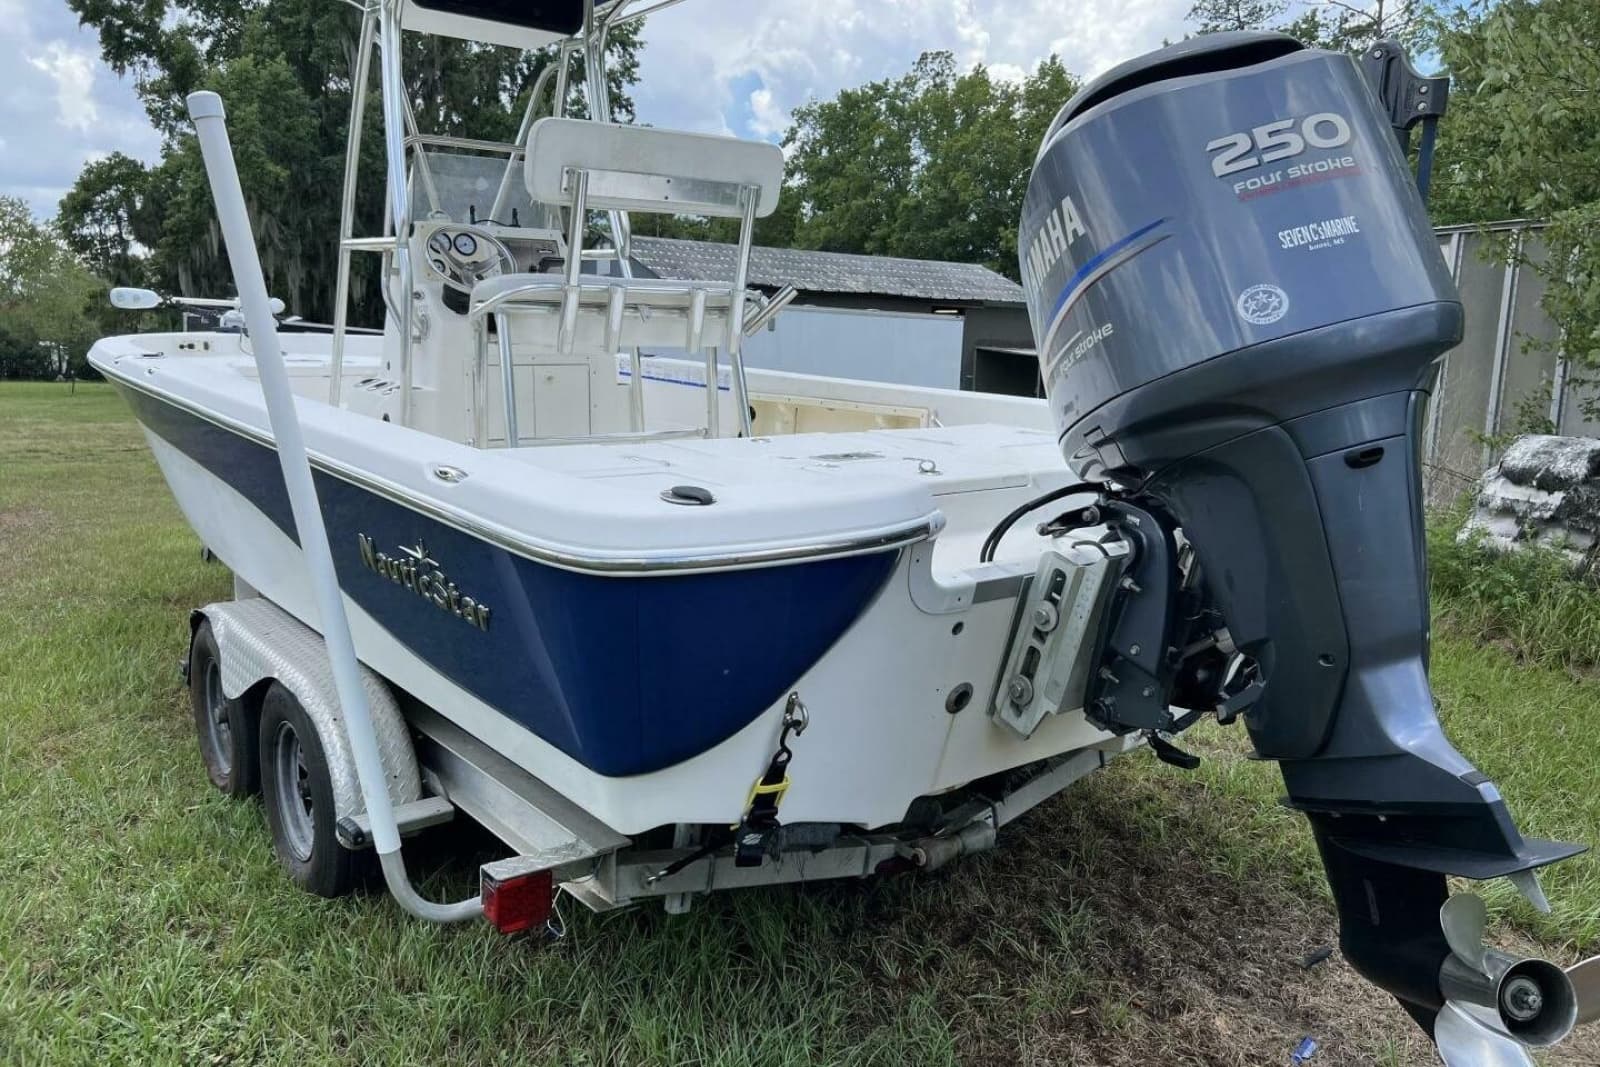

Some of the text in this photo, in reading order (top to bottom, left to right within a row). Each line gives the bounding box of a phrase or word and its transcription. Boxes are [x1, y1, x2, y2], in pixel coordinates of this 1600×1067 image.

[1206, 112, 1351, 178] 250
[1278, 226, 1312, 249] SEVEN
[1321, 215, 1361, 240] MARINE
[357, 532, 489, 632] NauticStar
